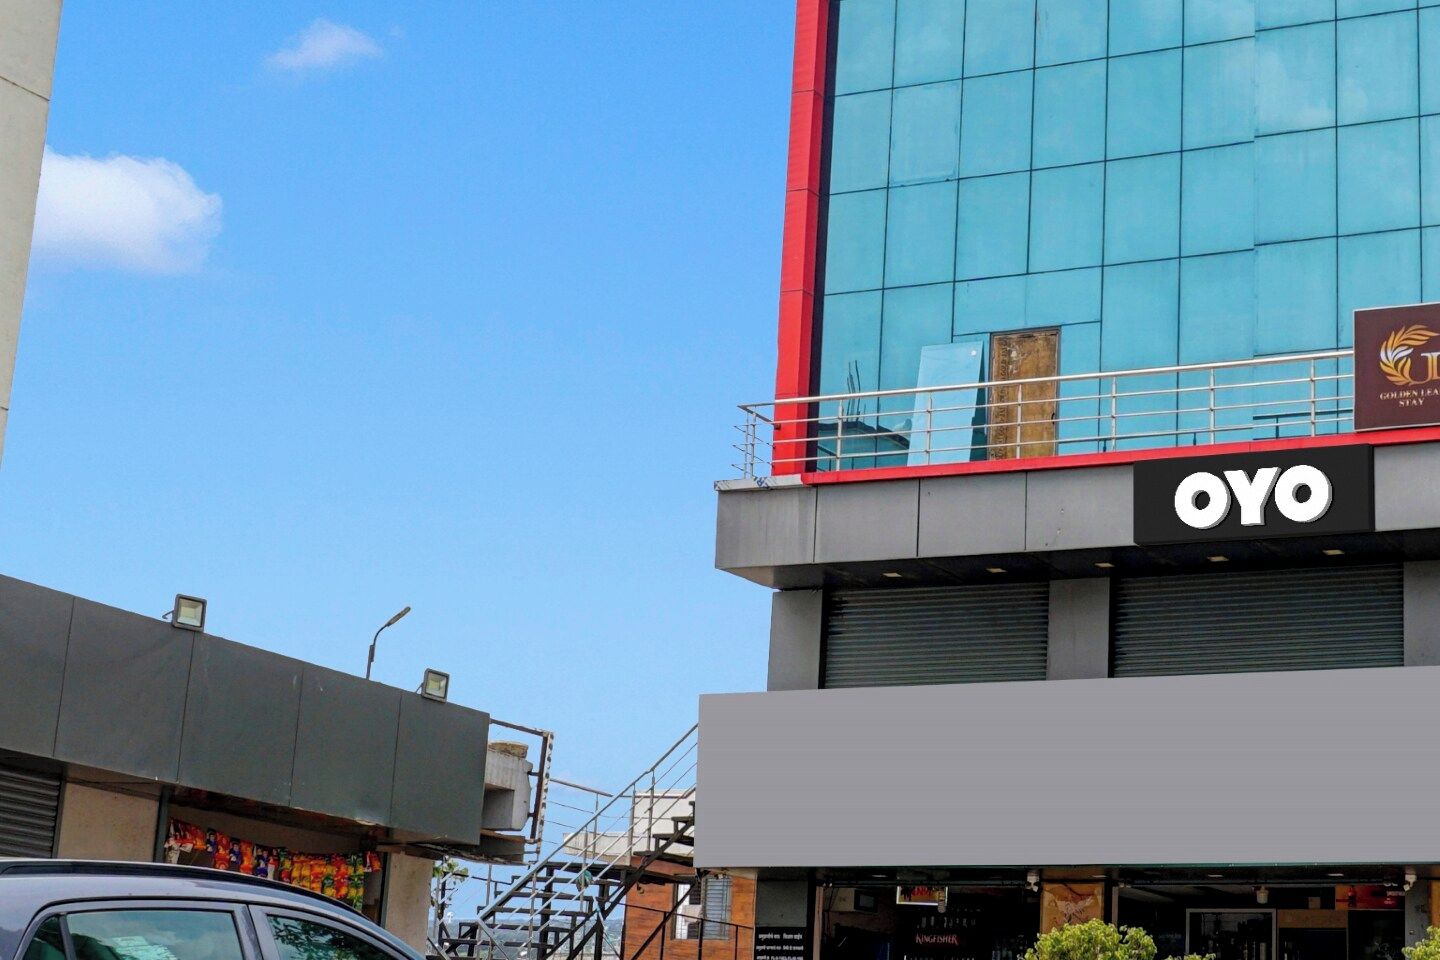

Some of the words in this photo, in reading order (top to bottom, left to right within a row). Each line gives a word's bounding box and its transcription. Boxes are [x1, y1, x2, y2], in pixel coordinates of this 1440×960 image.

[1379, 390, 1418, 400] GOLDEN
[1399, 397, 1425, 408] STAY
[1174, 464, 1333, 530] OYO
[915, 933, 959, 946] KINGFISHER
